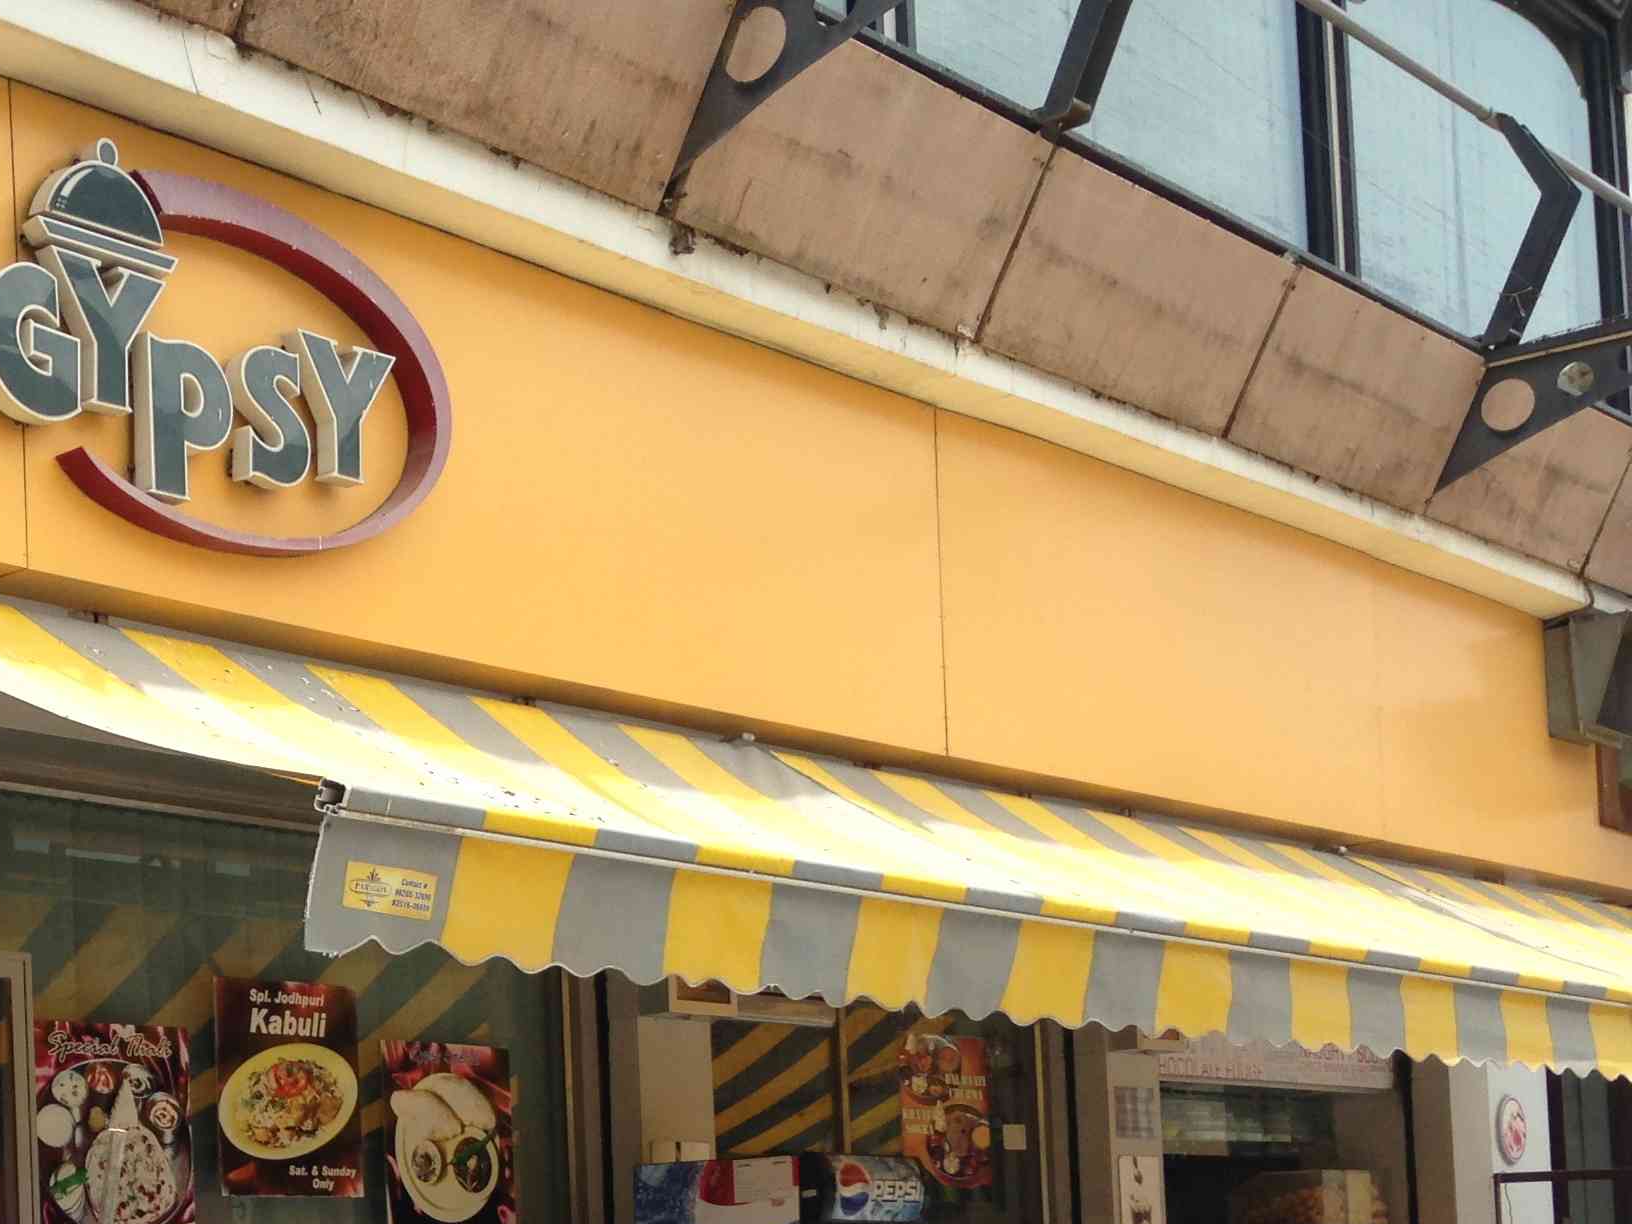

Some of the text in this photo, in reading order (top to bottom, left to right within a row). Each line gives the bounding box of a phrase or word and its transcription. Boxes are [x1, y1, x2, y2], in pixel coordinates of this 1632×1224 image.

[274, 991, 325, 1008] Jodhpuri
[249, 1007, 327, 1037] Kabuli
[48, 1031, 120, 1063] Special
[289, 1165, 308, 1176] Sat.
[321, 1165, 357, 1178] Sunday
[312, 1178, 335, 1191] Only
[872, 1179, 921, 1202] PEPSI
